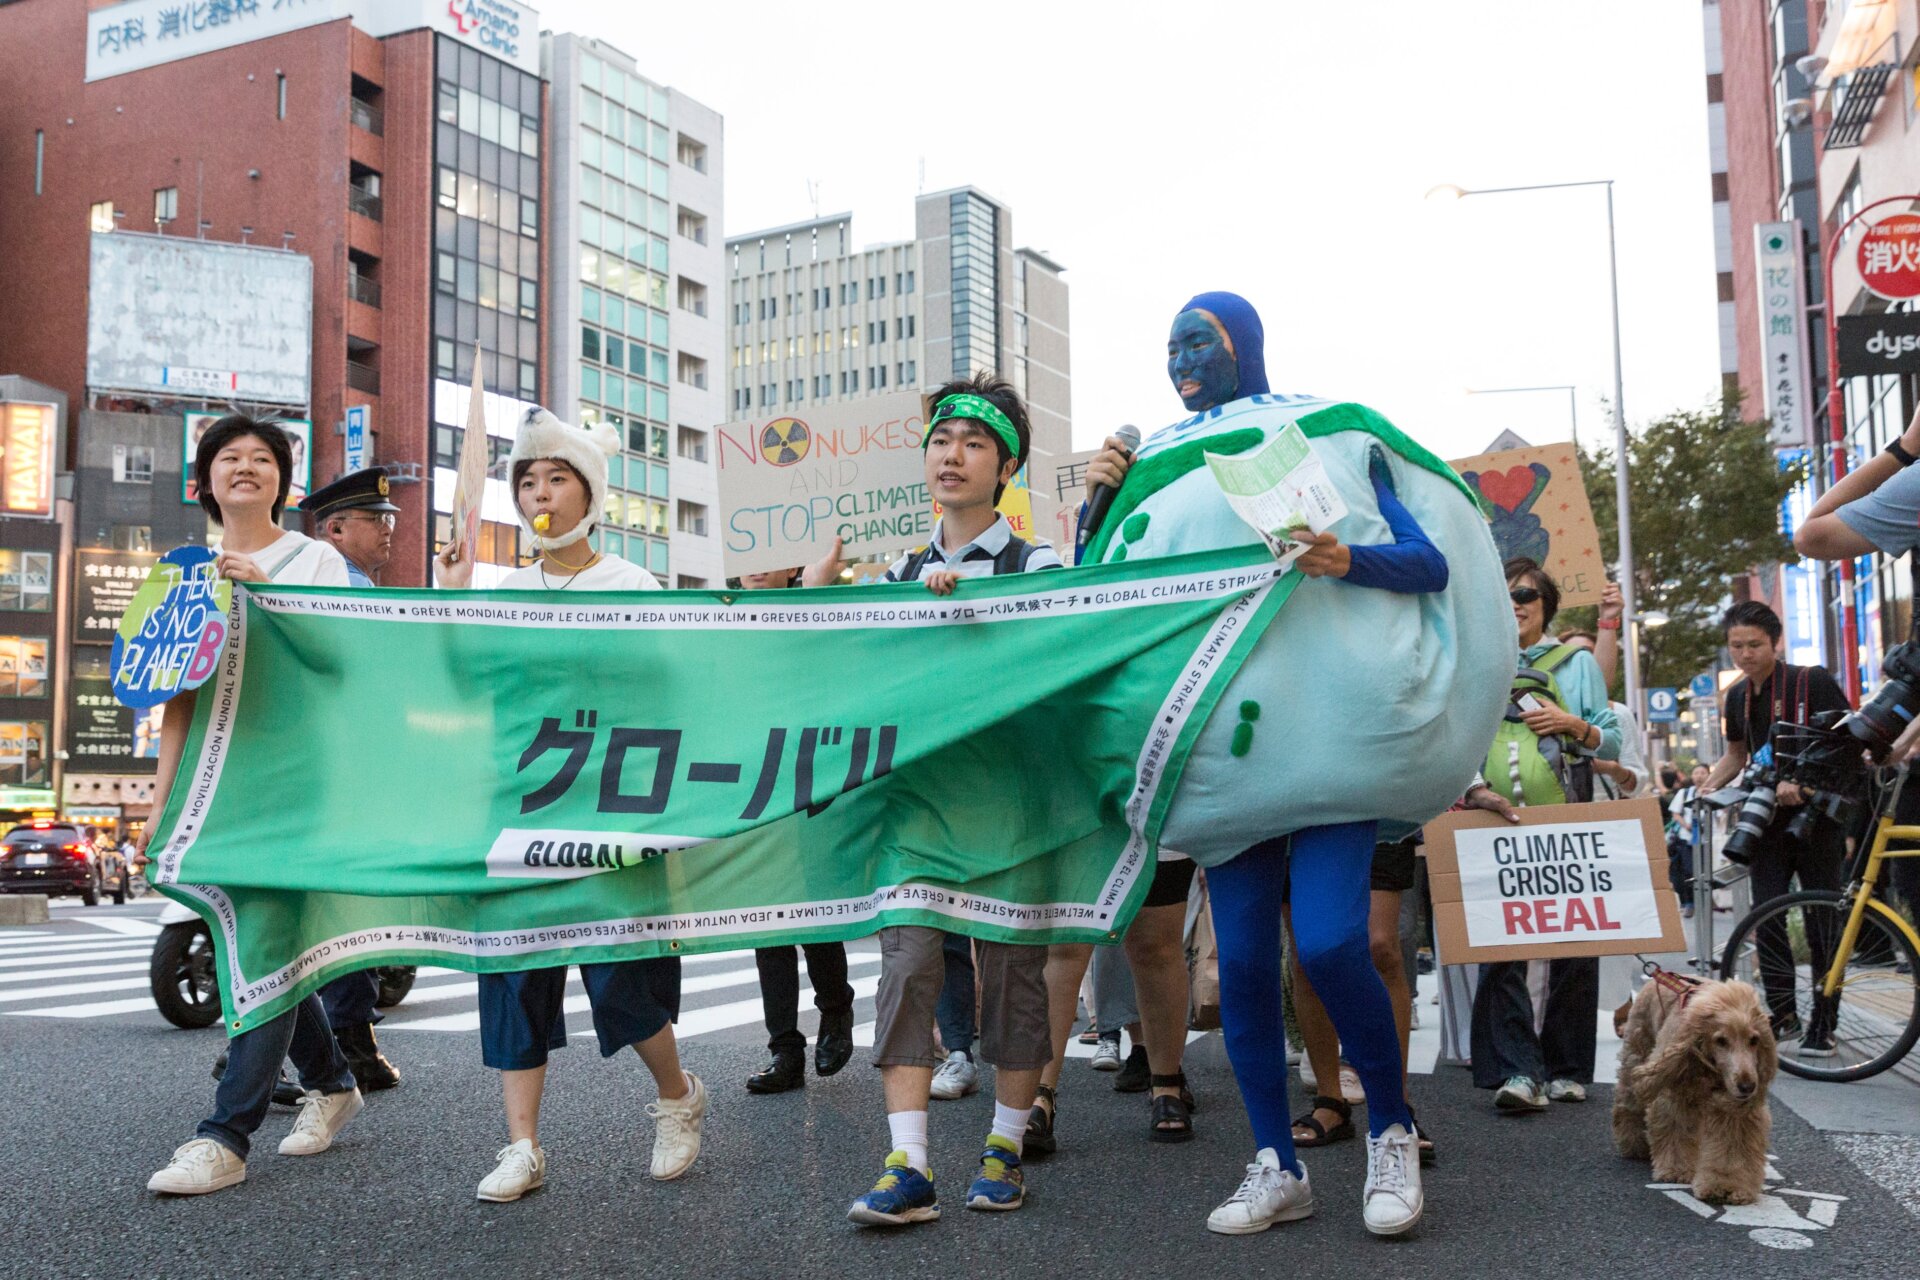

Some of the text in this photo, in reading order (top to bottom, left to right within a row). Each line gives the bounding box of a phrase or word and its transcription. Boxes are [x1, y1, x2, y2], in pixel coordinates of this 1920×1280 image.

[465, 0, 519, 37] Amano
[98, 16, 147, 57] 内科
[479, 26, 518, 58] Clinic
[1870, 225, 1891, 236] FIRE
[816, 416, 923, 459] NUKES
[8, 407, 42, 510] HAWAII
[789, 459, 859, 496] AND
[836, 482, 933, 518] CLIMATE
[727, 496, 834, 553] STOP
[837, 510, 931, 545] CHANGE
[161, 562, 227, 602] THERE
[1095, 572, 1270, 604] GLOBAL CLIMATE STRIKE
[248, 594, 393, 615] TWEITE KLIMASTREIK
[411, 605, 621, 623] GRÈVE MONDIALE POUR LE CLIMAT
[635, 612, 746, 623] JEDA UNTUK IKLIM
[761, 609, 936, 623] GREVES GLOBAIS PELO CLIMA
[952, 596, 1078, 619] グローバル気候マーチ
[138, 603, 207, 641] IS NO
[113, 620, 225, 693] PLANET B
[1198, 616, 1237, 669] CLIMATE
[190, 594, 240, 818] MOVILIZACIÓN MUNDIAL POR EL CLIMA
[1170, 670, 1202, 714] STRIKE
[516, 709, 898, 820] グローバル
[524, 840, 625, 869] GLOBAL
[1493, 831, 1609, 865] CLIMATE
[1121, 867, 1132, 877] EL
[1498, 863, 1612, 898] CRISIS is
[853, 902, 872, 913] POUR
[904, 888, 944, 903] GRÈVE
[1103, 878, 1124, 907] CLIMA
[657, 911, 772, 931] JEDA UNTUK IKLIM
[789, 905, 833, 919] CLIMAT
[837, 904, 849, 915] LE
[961, 898, 1094, 920] WELTWEITE KLIMASTREIK
[1501, 896, 1621, 936] REAL
[504, 934, 535, 946] PELO
[540, 928, 592, 942] GLOBAIS
[595, 922, 643, 936] GREVES
[249, 932, 382, 1000] GLOBAL CLIMATE STRIKE
